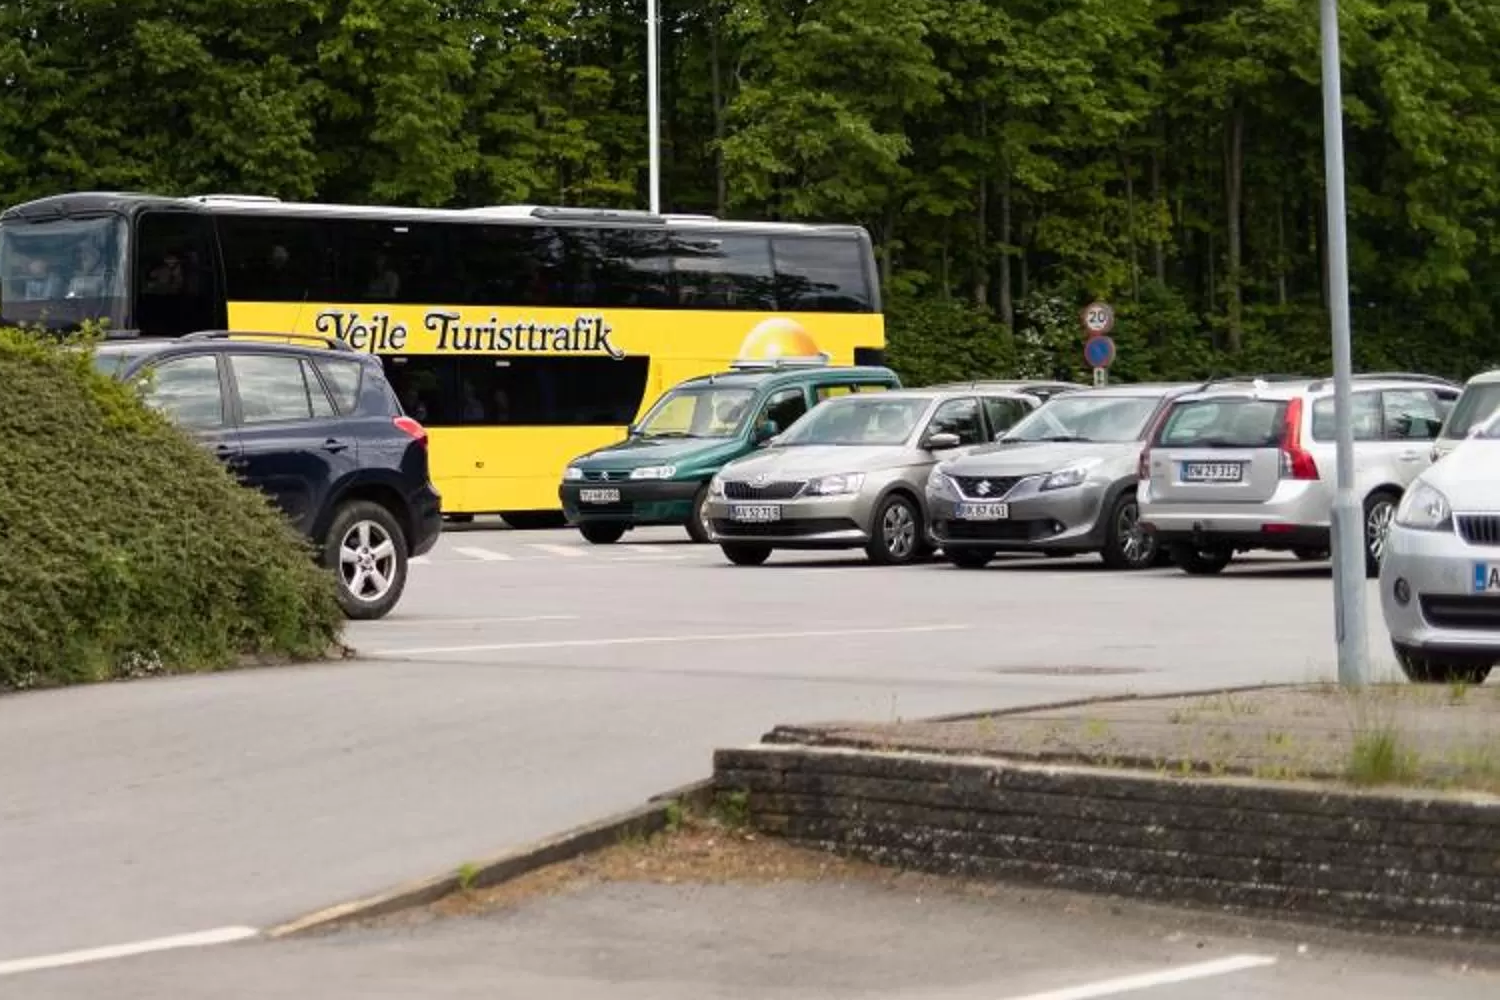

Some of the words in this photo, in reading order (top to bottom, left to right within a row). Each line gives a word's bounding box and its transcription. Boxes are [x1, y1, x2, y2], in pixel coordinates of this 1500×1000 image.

[1089, 311, 1106, 323] 20
[315, 313, 407, 352] Vejle
[425, 313, 625, 359] Turisttrafik
